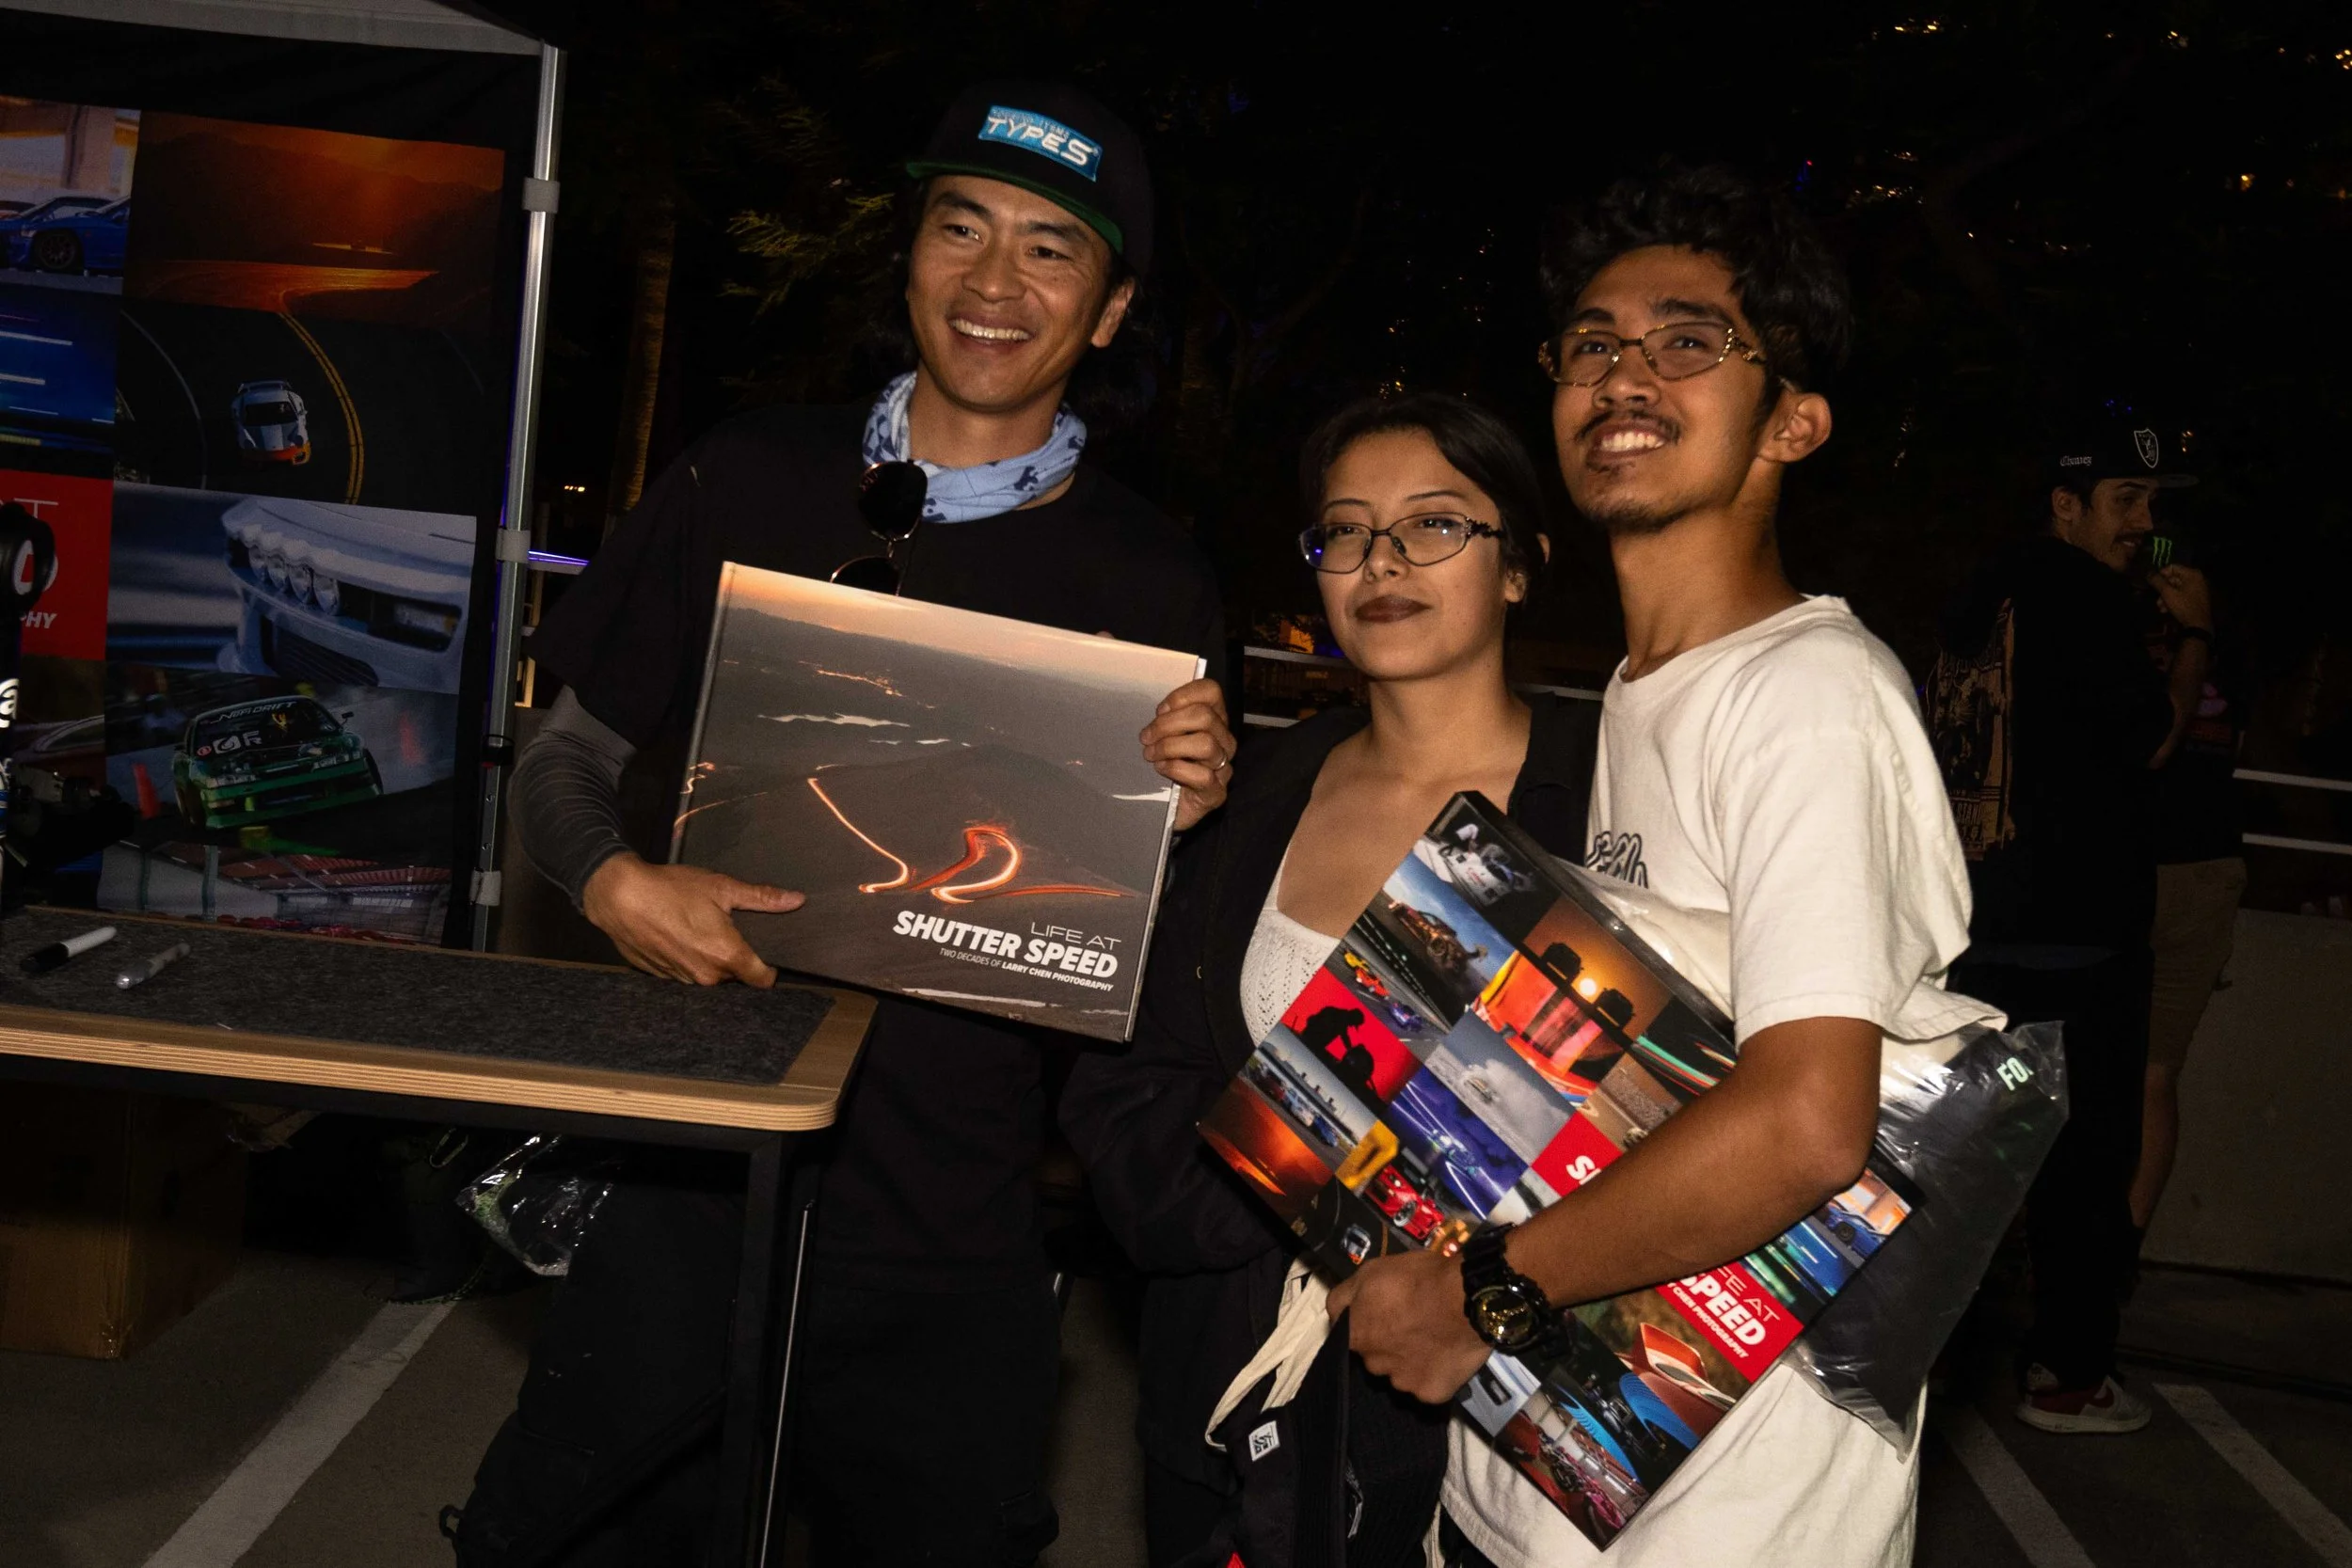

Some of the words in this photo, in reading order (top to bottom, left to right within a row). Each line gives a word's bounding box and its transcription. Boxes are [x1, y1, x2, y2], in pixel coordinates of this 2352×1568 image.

[892, 910, 1023, 959] SHUTTER
[1024, 938, 1119, 979] SPEED
[1030, 921, 1084, 944] LIFE
[1086, 934, 1122, 951] AT
[939, 947, 957, 959] TWO
[956, 950, 991, 967] DECADES
[990, 958, 1002, 968] OF
[1001, 960, 1028, 974] LARRY
[1028, 966, 1052, 979] CHEN
[1052, 971, 1114, 992] PHOTOGRAPHY
[1996, 1056, 2035, 1091] FO
[1743, 1297, 1781, 1323] AT
[1691, 1305, 1750, 1359] PHOTOGRAPHY
